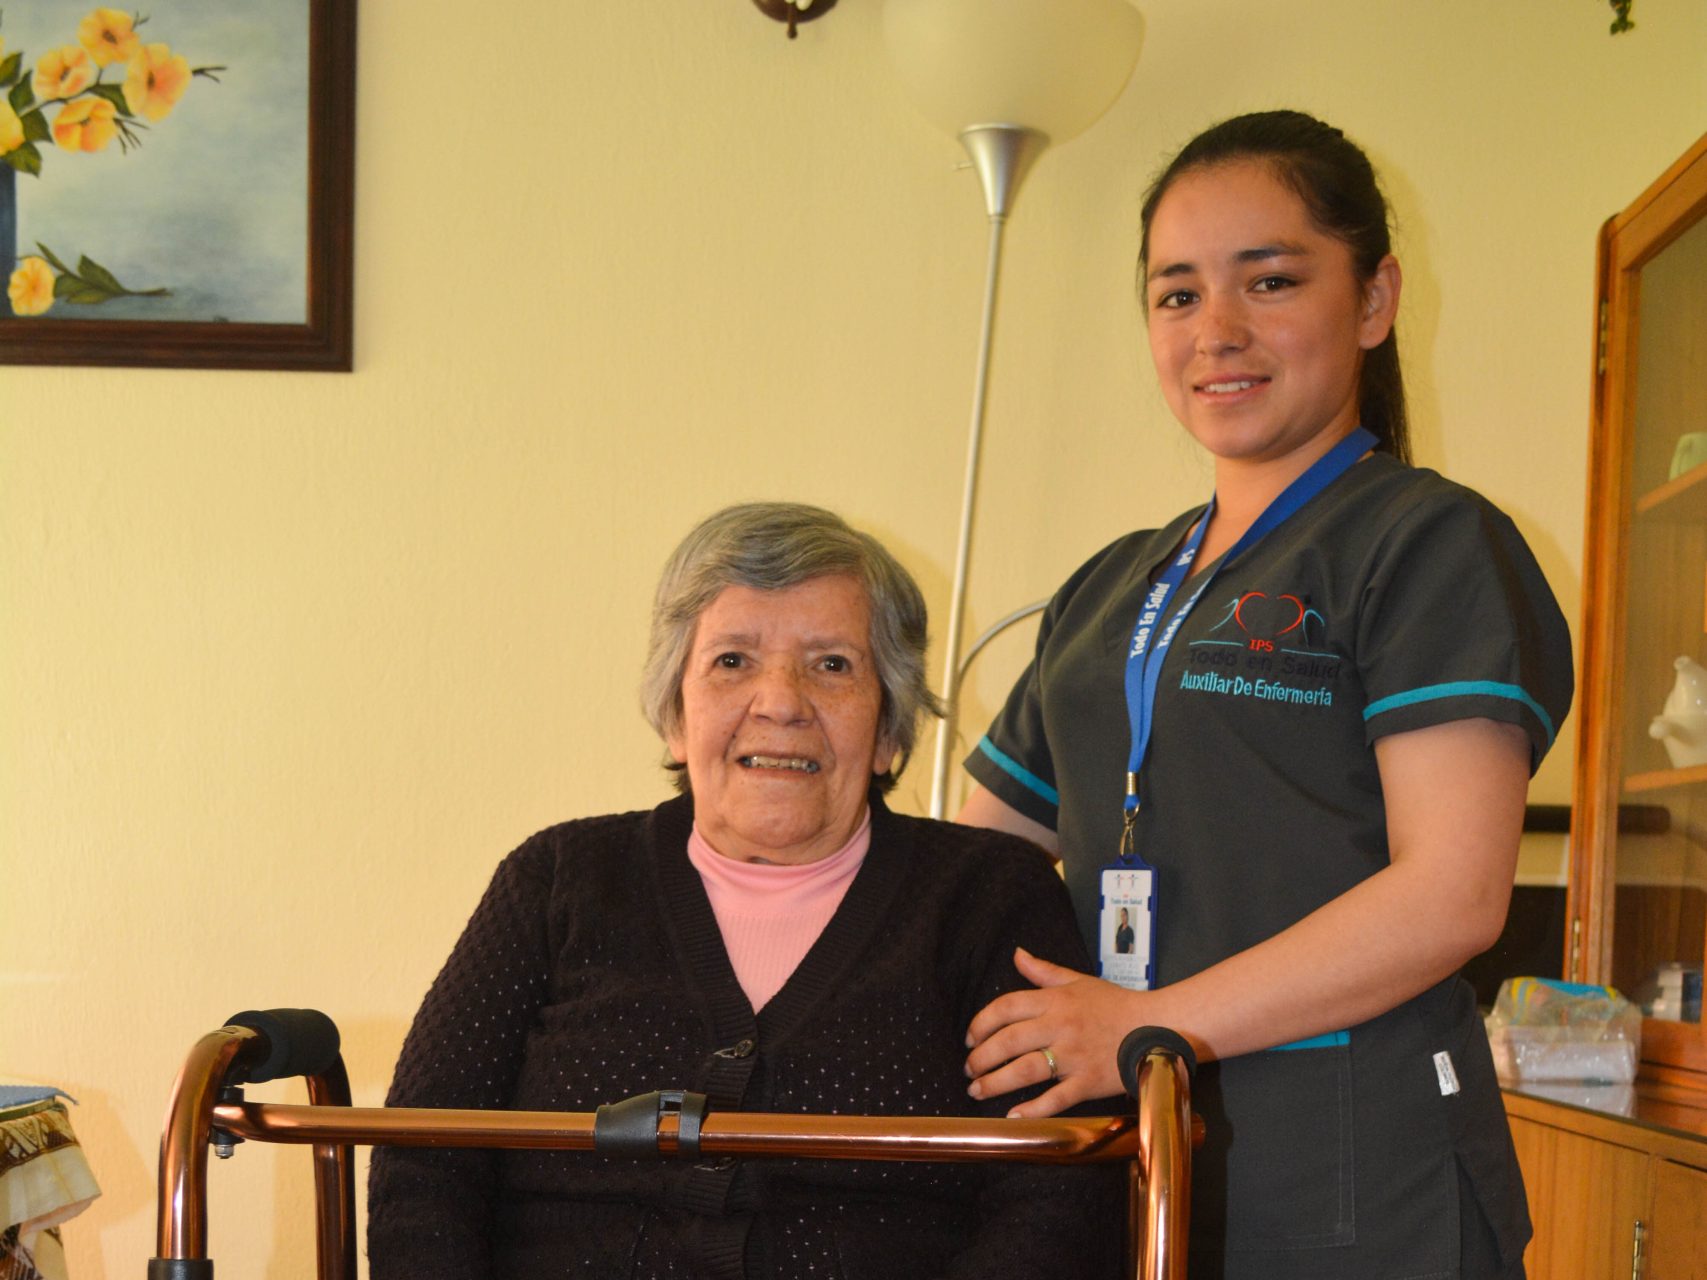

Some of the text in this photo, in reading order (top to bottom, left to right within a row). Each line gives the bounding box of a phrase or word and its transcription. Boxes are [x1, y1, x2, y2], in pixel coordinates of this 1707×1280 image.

[1130, 582, 1171, 659] Todo En Salud
[1249, 639, 1274, 652] IPS
[1188, 648, 1341, 680] Todo en Salud
[1180, 670, 1233, 695] Auxiliar
[1233, 676, 1252, 695] De
